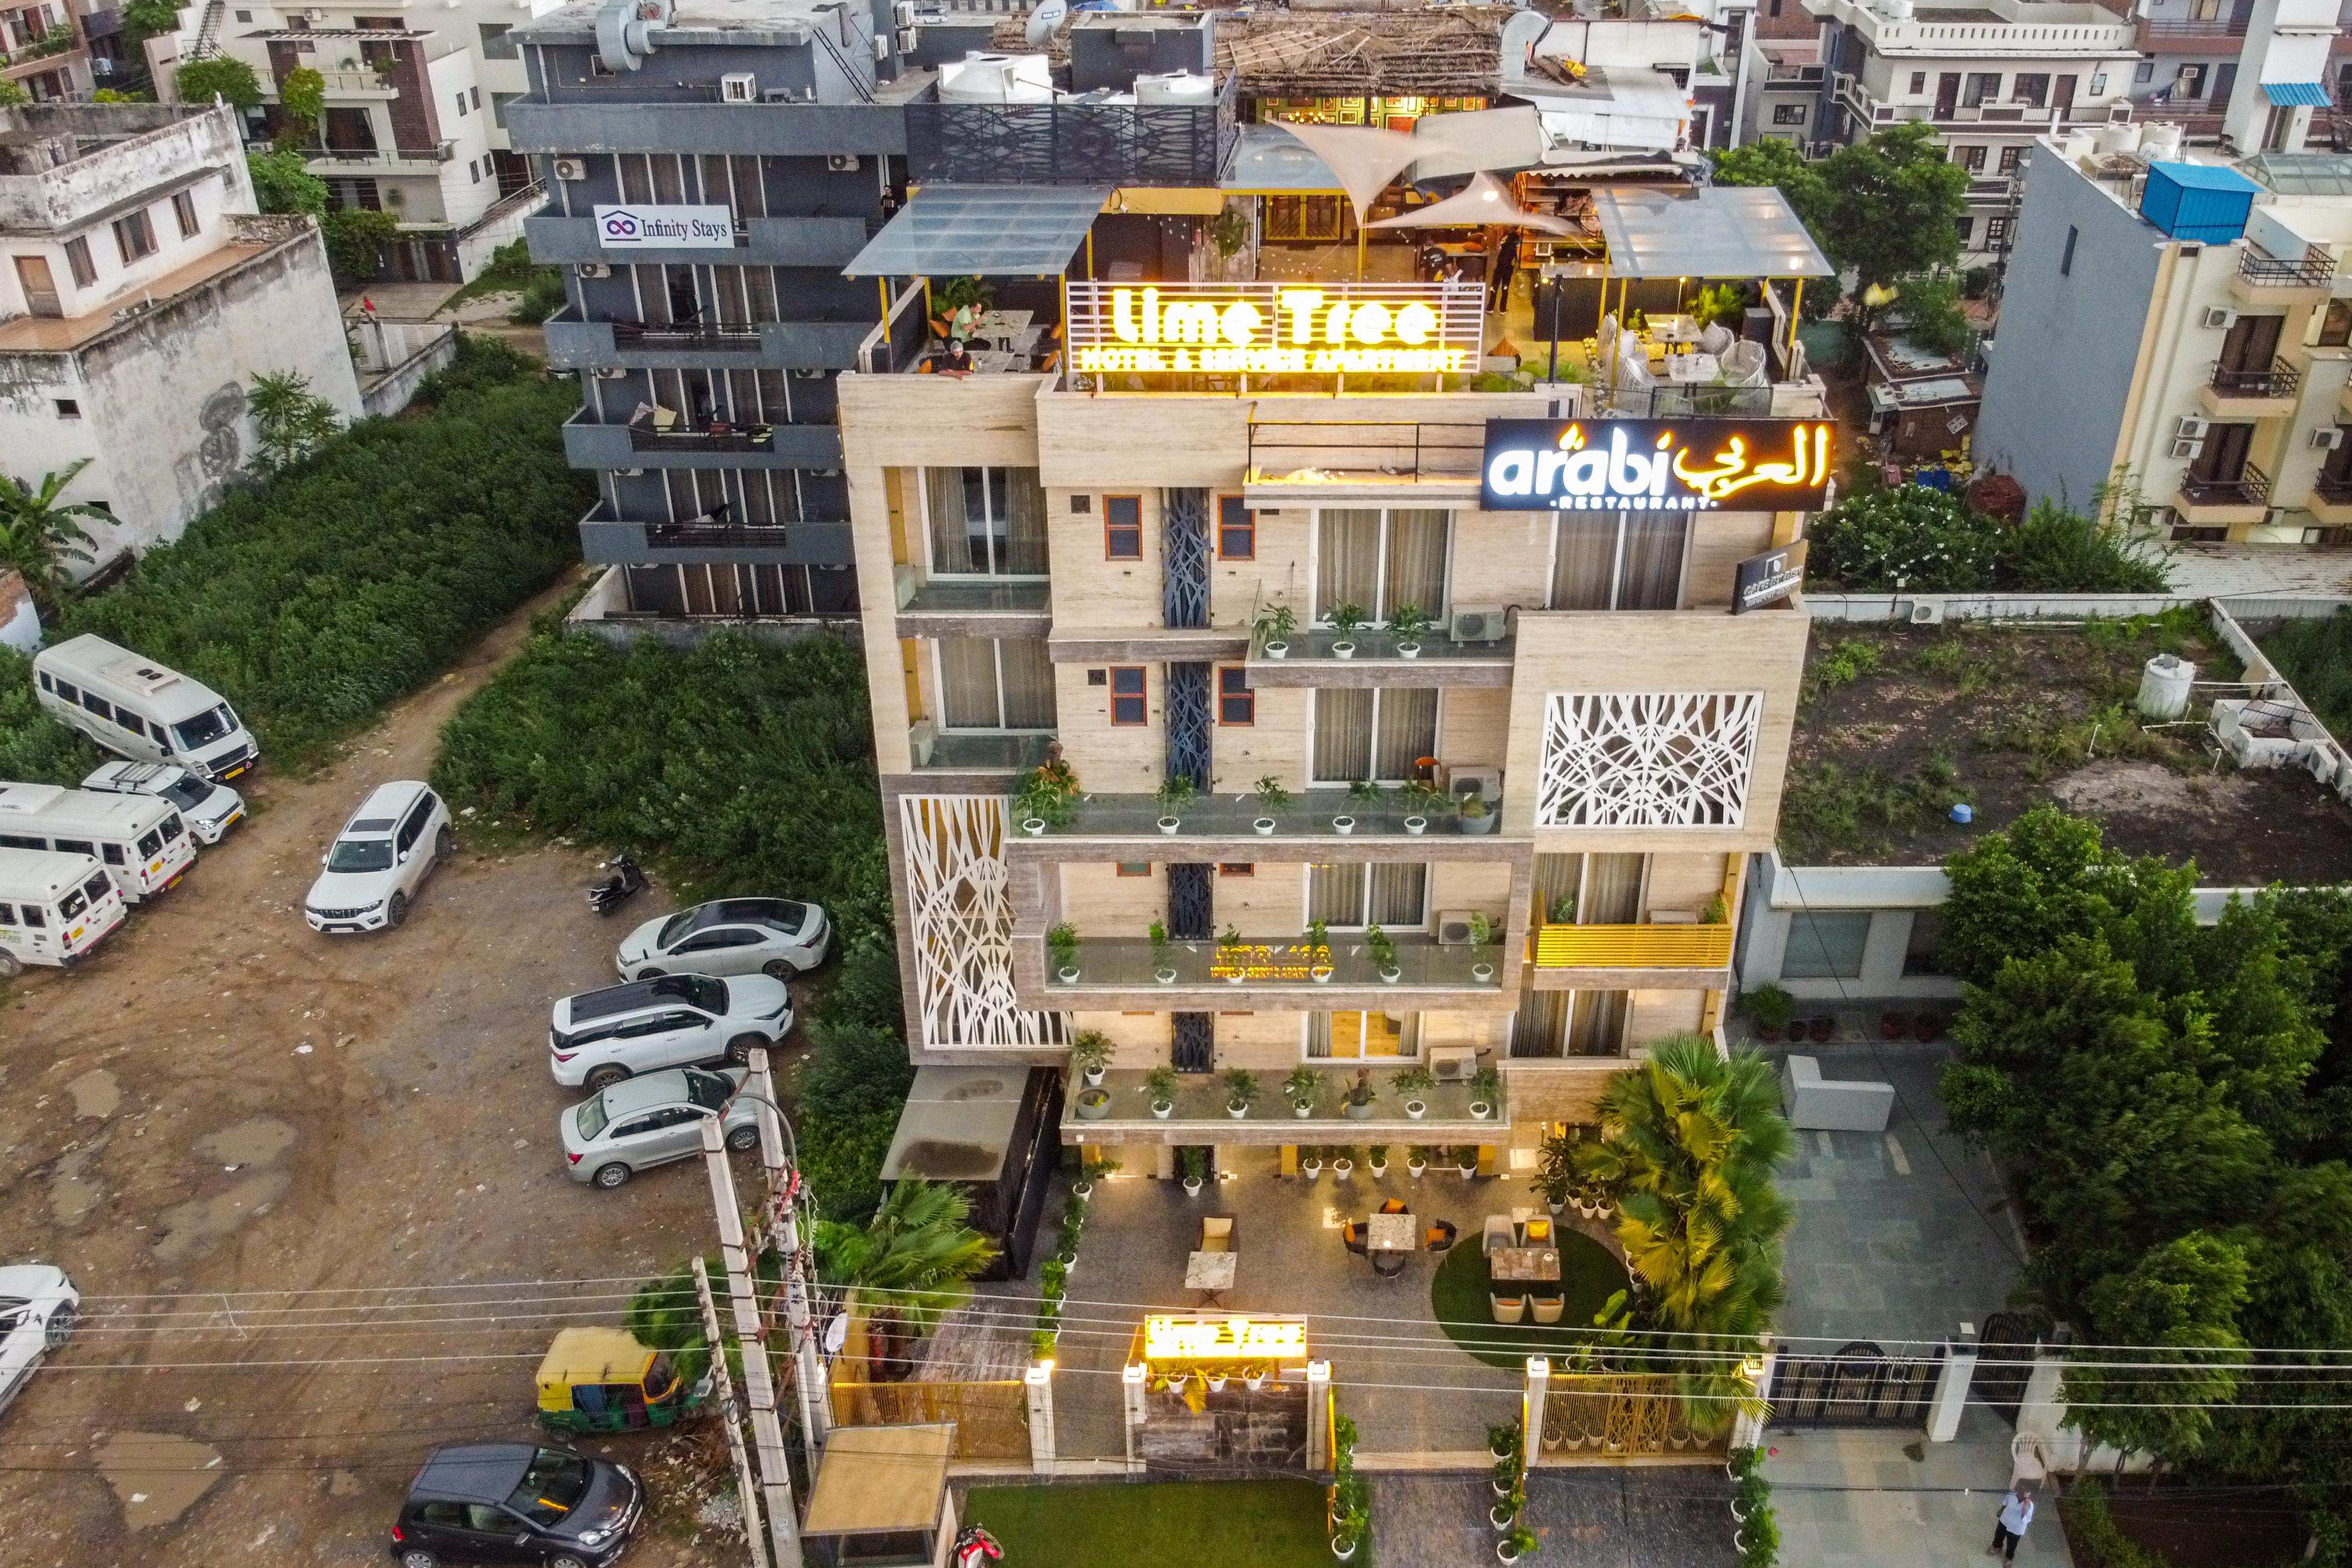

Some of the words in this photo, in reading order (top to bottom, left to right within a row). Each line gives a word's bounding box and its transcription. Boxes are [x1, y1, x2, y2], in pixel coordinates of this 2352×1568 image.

[641, 219, 688, 242] Infinity
[692, 219, 727, 242] Stays
[1279, 289, 1438, 346] Tree
[1082, 348, 1164, 371] HOTEL
[1173, 348, 1193, 371] &
[1200, 348, 1305, 371] SERVICE
[1312, 348, 1465, 371] APARTMENT
[1488, 424, 1670, 496] arabi
[1558, 496, 1711, 510] RESTAURANT
